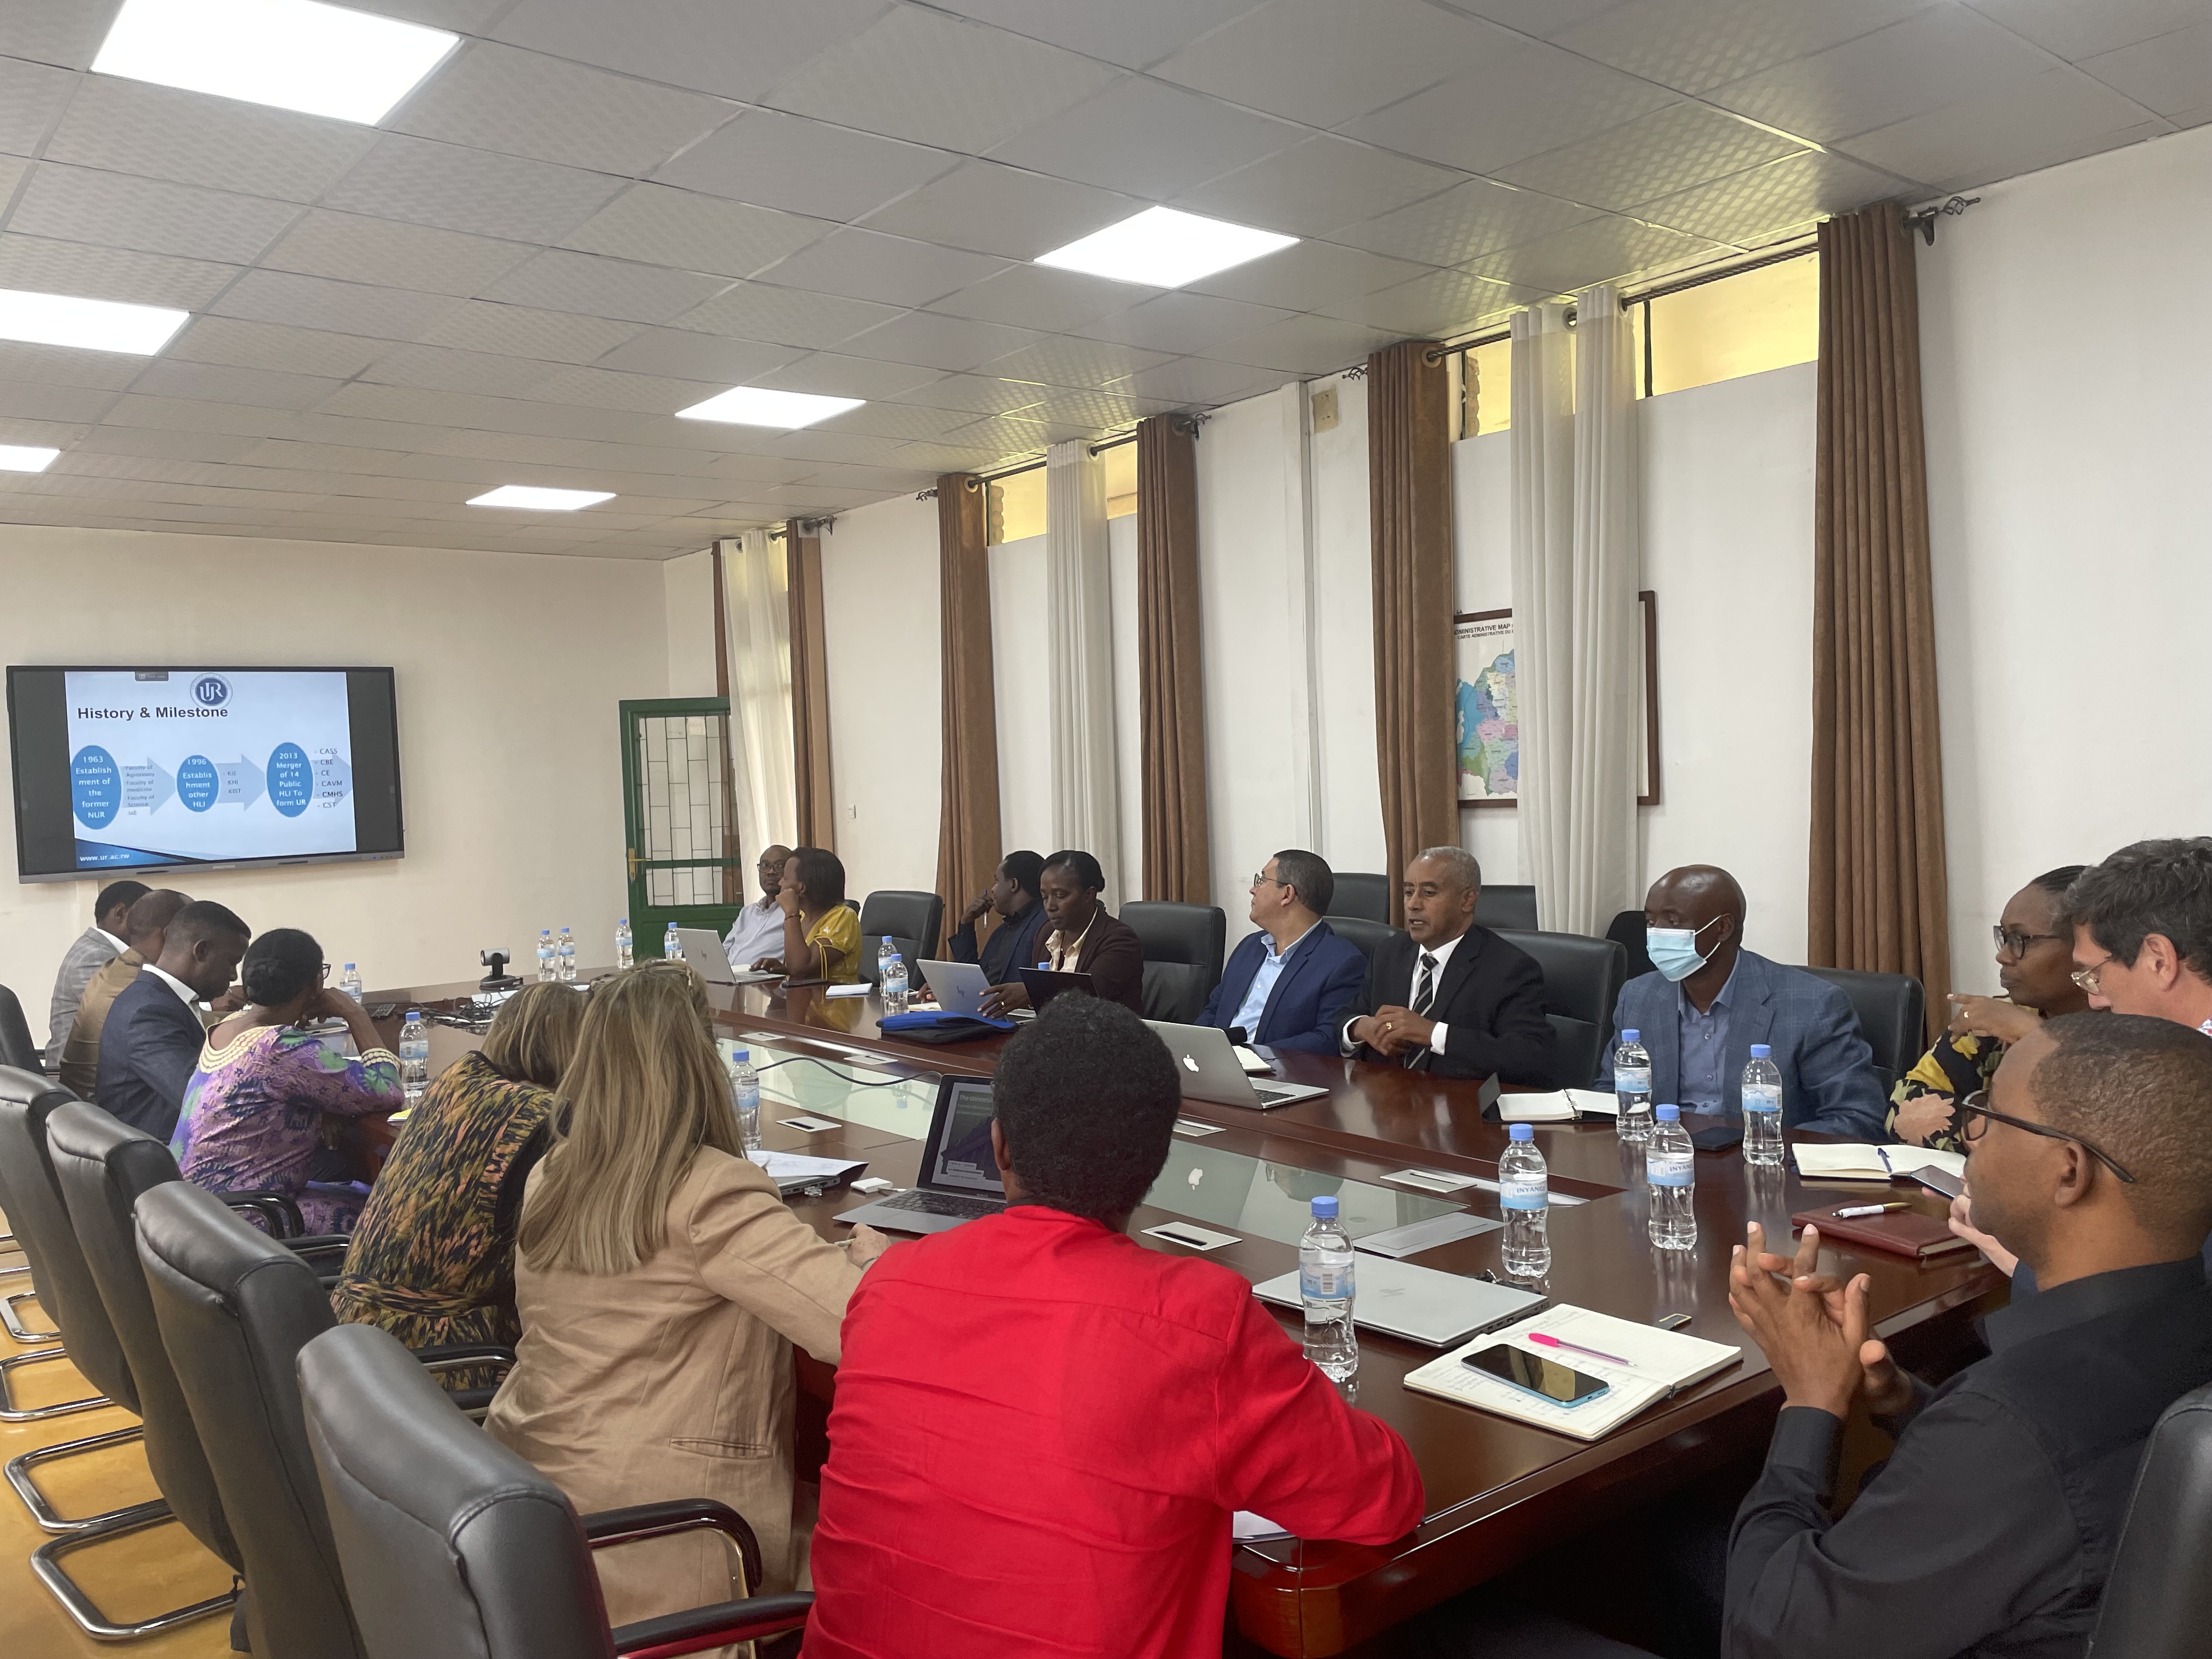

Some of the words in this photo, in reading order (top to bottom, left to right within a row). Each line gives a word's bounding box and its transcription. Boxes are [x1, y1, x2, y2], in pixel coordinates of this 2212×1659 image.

[78, 707, 134, 721] History
[140, 707, 151, 718] &
[156, 707, 228, 718] Milestone
